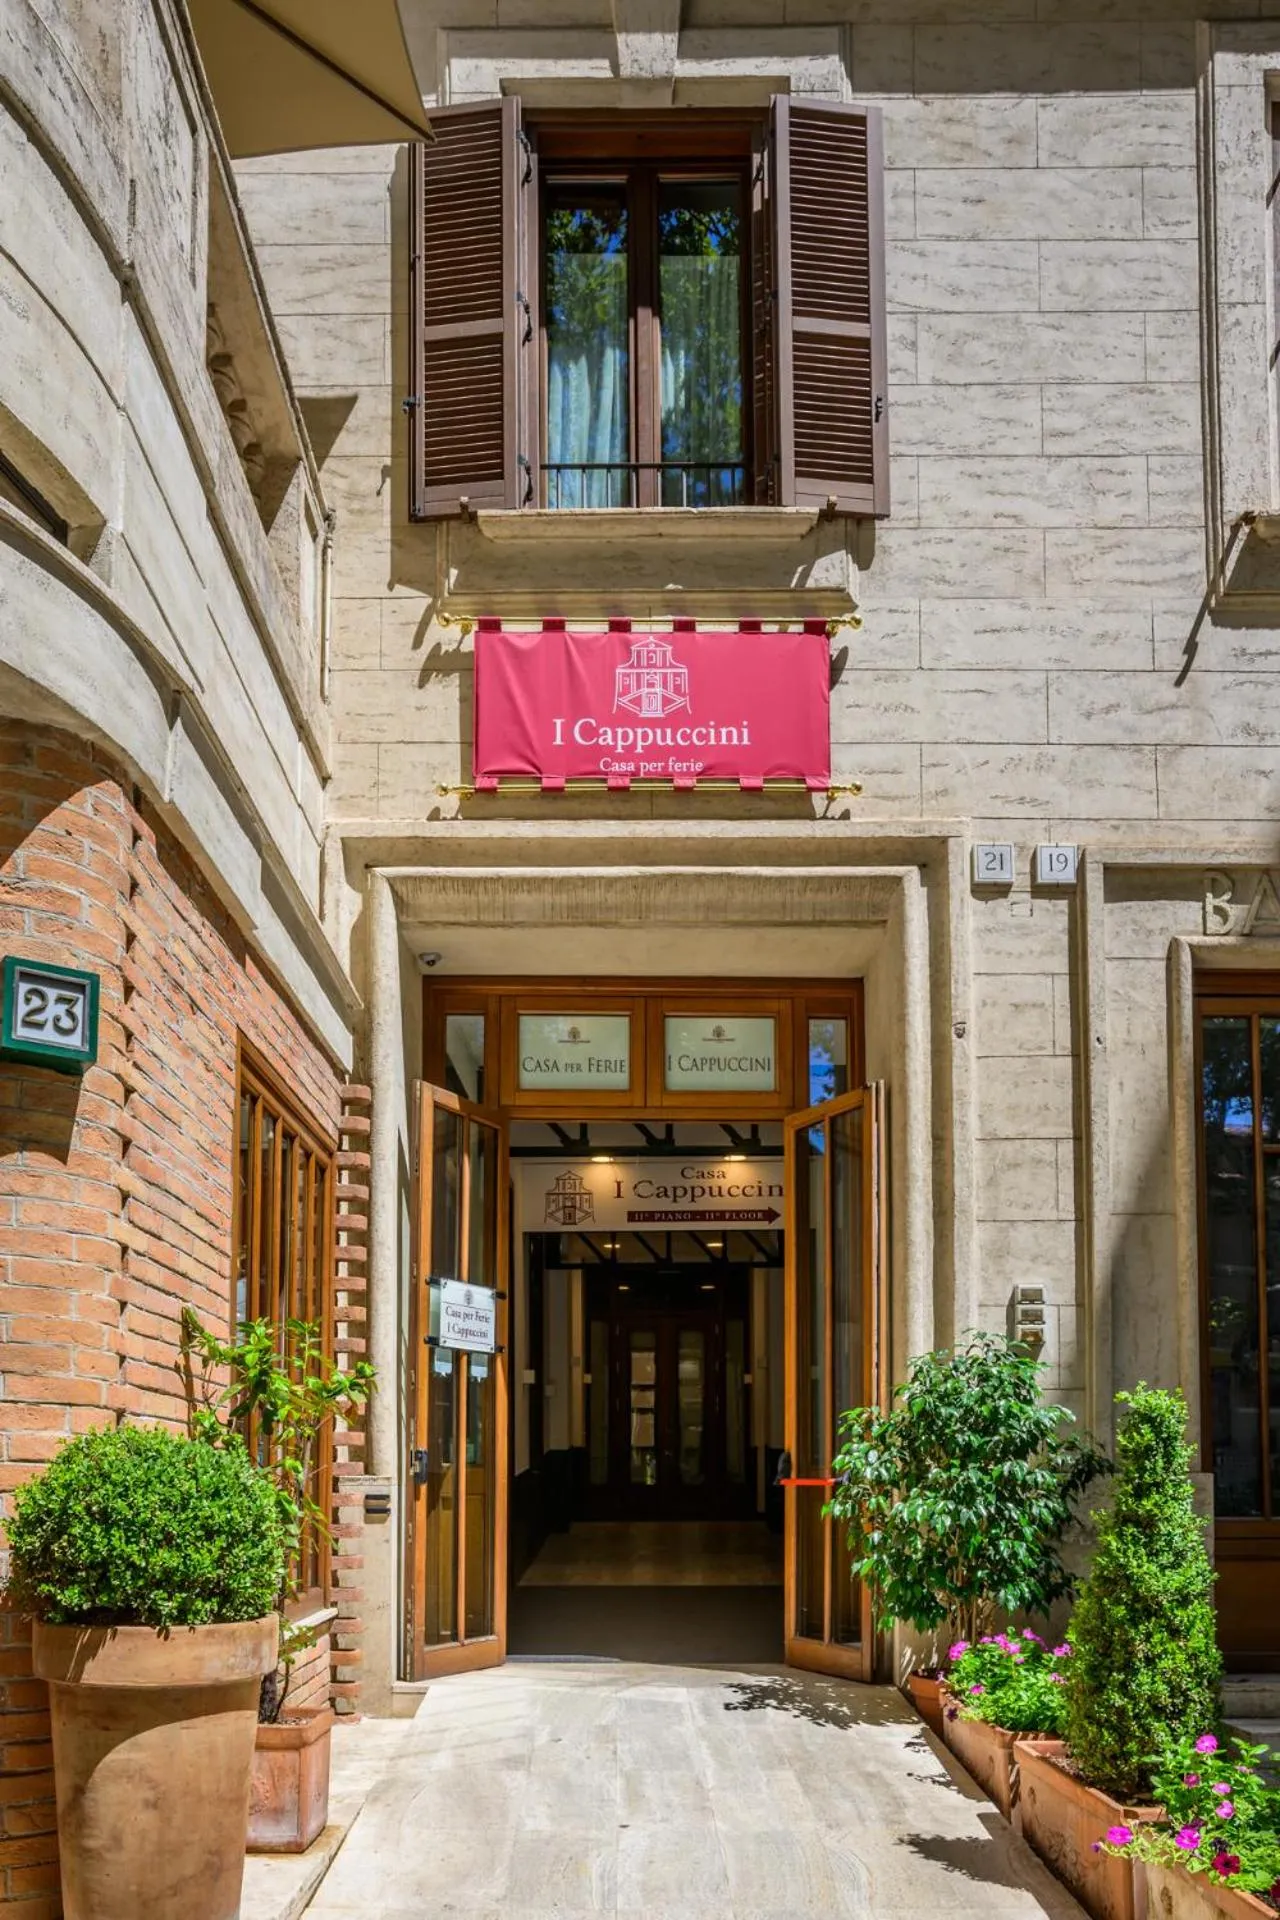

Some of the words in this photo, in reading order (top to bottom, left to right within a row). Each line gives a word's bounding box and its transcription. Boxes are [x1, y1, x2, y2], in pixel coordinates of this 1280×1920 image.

[552, 718, 565, 746] I
[573, 717, 751, 753] Cappuccini
[599, 757, 635, 772] Casa
[640, 761, 665, 777] per
[668, 756, 704, 772] ferie
[984, 851, 1005, 872] 21
[1049, 852, 1068, 873] 19
[21, 986, 80, 1036] 23
[522, 1056, 560, 1073] CASA
[588, 1056, 627, 1073] FERIE
[667, 1054, 672, 1072] I
[678, 1054, 771, 1073] CAPPUCCINI
[680, 1166, 727, 1180] Casa
[614, 1180, 625, 1199] I
[632, 1179, 784, 1203] Cappuccin
[654, 1210, 692, 1221] PIANO
[725, 1209, 765, 1220] FLOOR
[445, 1305, 462, 1318] Casa
[463, 1311, 474, 1322] per
[475, 1311, 490, 1323] Ferie
[451, 1323, 489, 1339] Cappuccini
